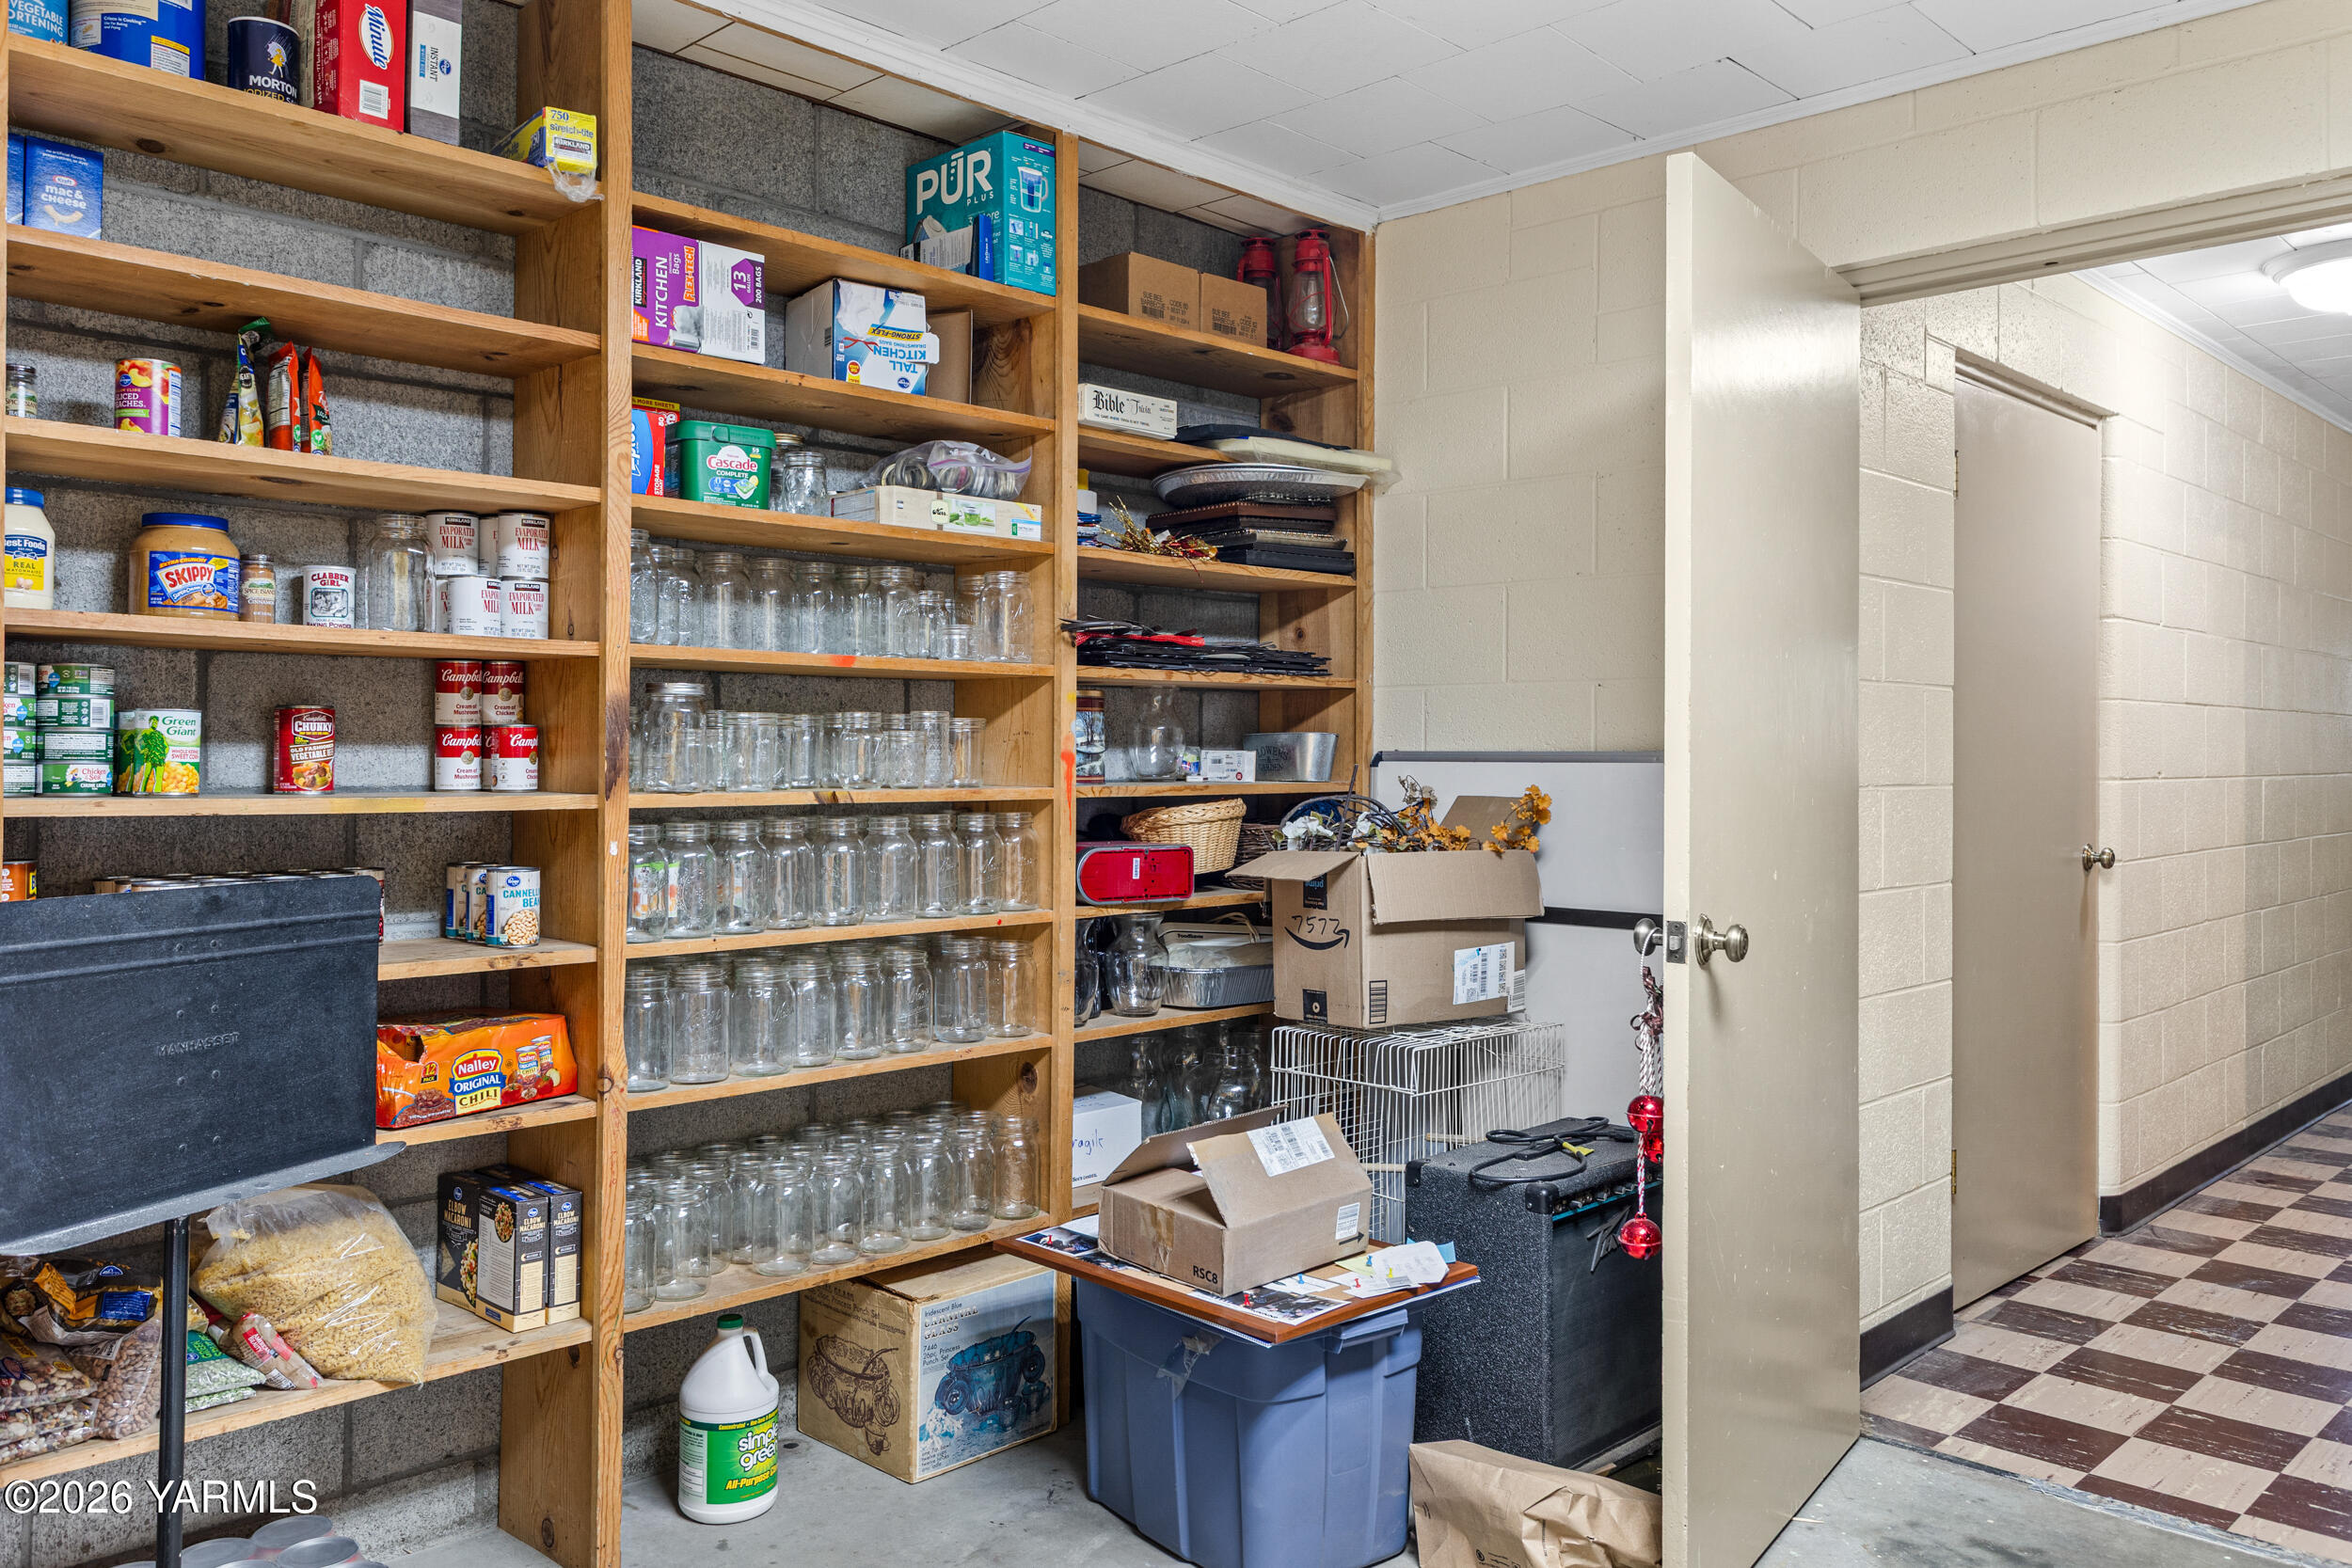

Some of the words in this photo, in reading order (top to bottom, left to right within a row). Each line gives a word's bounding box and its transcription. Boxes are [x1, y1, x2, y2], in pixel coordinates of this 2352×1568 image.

[10, 0, 64, 26] VEGETABLE
[8, 8, 64, 38] ORTENING
[365, 3, 389, 71] Minute
[430, 47, 439, 82] INSTANT
[248, 74, 297, 99] MORTON
[550, 110, 569, 121] 750
[556, 138, 590, 150] KIRKLAND
[45, 185, 72, 198] mac
[74, 190, 84, 199] &
[966, 191, 994, 207] PLUS
[673, 253, 681, 275] Bags
[684, 245, 695, 302] FLEX-TECH
[633, 259, 643, 305] KIRKLAND
[734, 271, 746, 291] 13
[655, 256, 668, 327] KITCHEN
[871, 327, 921, 340] STRONG-FLEX
[873, 345, 927, 359] KITCHEN
[888, 360, 918, 373] TALL
[637, 398, 653, 406] MORE
[654, 401, 675, 409] SHEETS
[1092, 389, 1125, 414] Bible
[707, 456, 757, 471] Cascade
[439, 526, 475, 537] EVAPORATED
[24, 539, 46, 550] Foods
[441, 535, 465, 549] MILK
[516, 536, 539, 550] MILK
[13, 562, 36, 570] REAL
[159, 559, 180, 569] EXTRA
[165, 566, 214, 588] SKIPPY
[311, 573, 349, 583] CLABBER
[511, 601, 534, 614] MILK
[482, 671, 524, 685] Campbell
[162, 716, 196, 725] Green
[294, 721, 332, 733] CHUNKY
[167, 726, 196, 736] Giant
[292, 750, 326, 761] VEGETABLE
[523, 897, 540, 908] BEA
[157, 1032, 240, 1057] MANHASSET
[518, 1054, 536, 1063] Nalley
[425, 1063, 437, 1075] 12
[457, 1059, 497, 1076] Nalley
[454, 1075, 501, 1092] ORIGINAL
[458, 1089, 498, 1106] CHILI
[1073, 1129, 1104, 1155] ragile
[448, 1199, 468, 1214] ELBOW
[443, 1211, 471, 1227] MACARONI
[524, 1216, 542, 1225] ELBOW
[553, 1216, 580, 1227] MACARONI
[557, 1210, 575, 1220] ELBOW
[519, 1222, 546, 1232] MACARONI
[1192, 1265, 1218, 1285] RSC8
[925, 1305, 950, 1317] Iridescent
[951, 1302, 962, 1310] Blue
[925, 1306, 978, 1327] CARNIVAL
[925, 1323, 959, 1339] GLASS
[247, 1335, 262, 1354] BEAUTY
[254, 1333, 271, 1355] AMERICAN
[939, 1345, 961, 1355] Princess
[923, 1357, 939, 1367] Punch
[718, 1421, 746, 1430] Concentrated
[724, 1470, 771, 1490] All-Purpose
